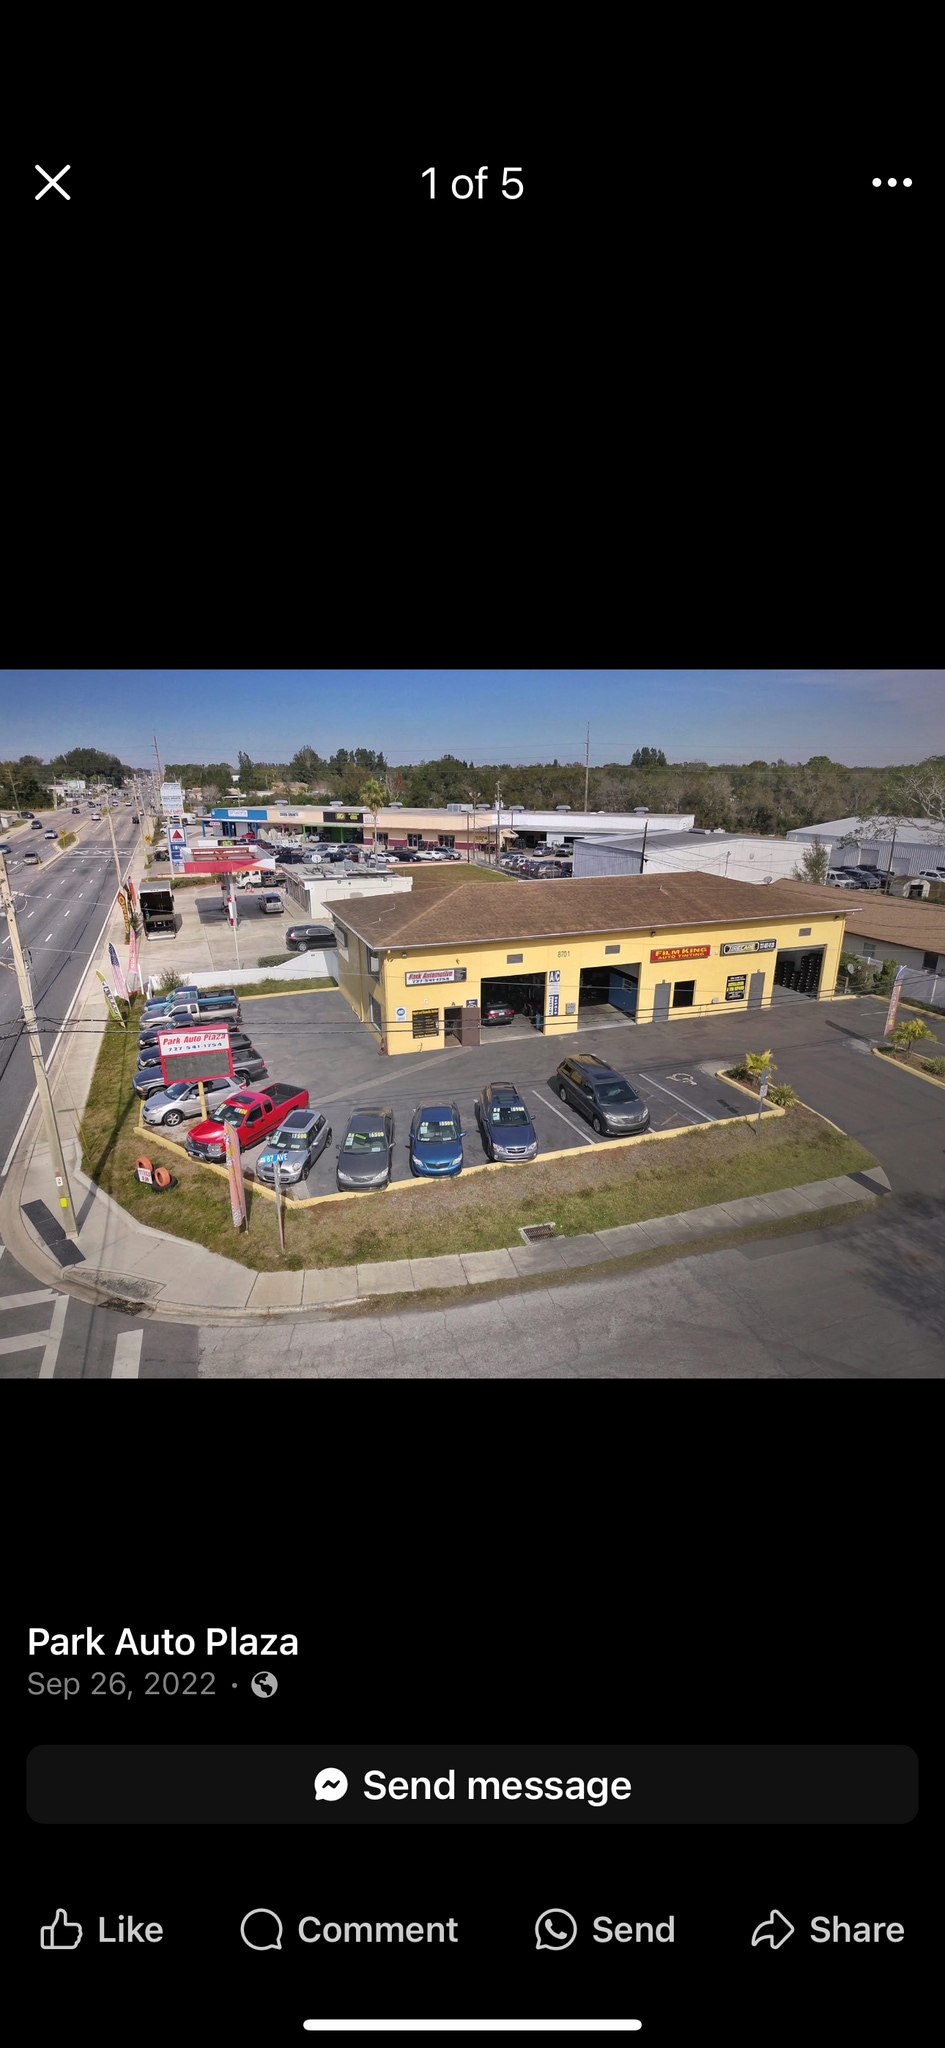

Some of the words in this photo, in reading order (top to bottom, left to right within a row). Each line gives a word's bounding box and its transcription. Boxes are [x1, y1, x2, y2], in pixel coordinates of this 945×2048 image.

[163, 1037, 181, 1045] Park
[184, 1035, 202, 1043] Auto
[204, 1033, 226, 1041] Plaza
[277, 1152, 288, 1162] AVE
